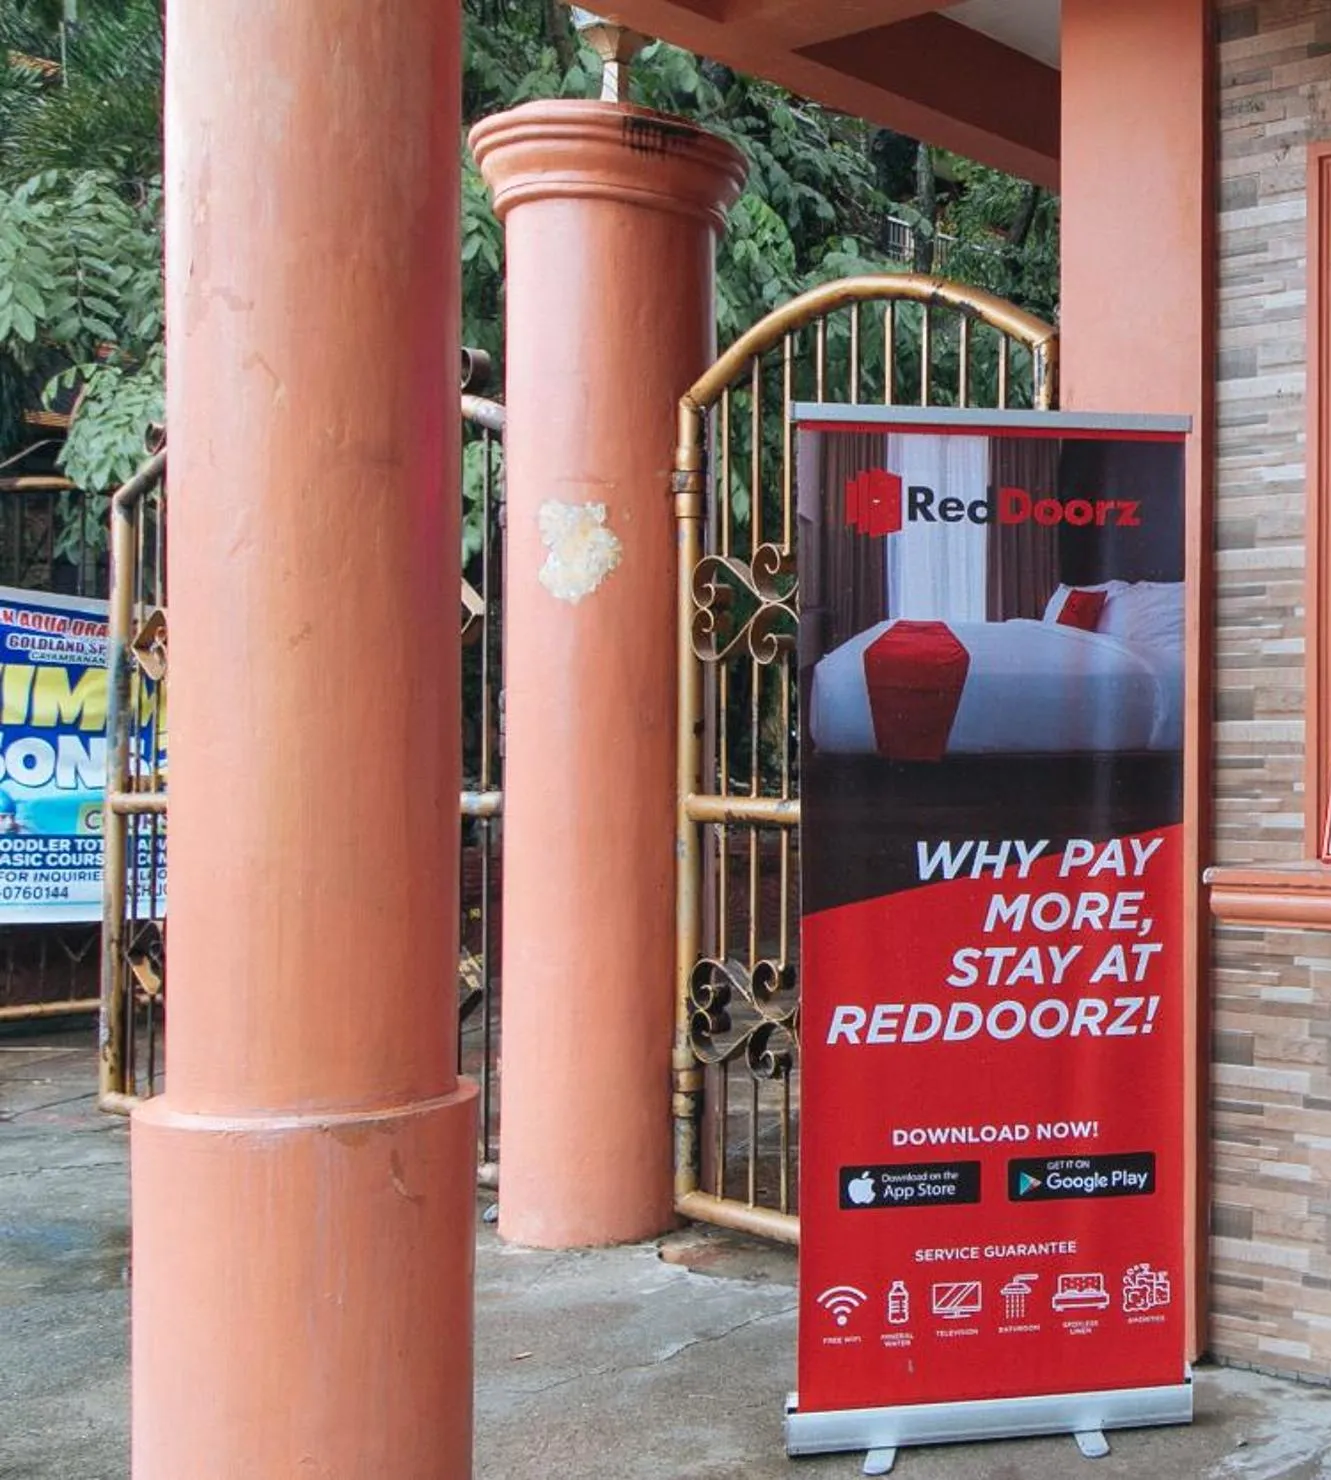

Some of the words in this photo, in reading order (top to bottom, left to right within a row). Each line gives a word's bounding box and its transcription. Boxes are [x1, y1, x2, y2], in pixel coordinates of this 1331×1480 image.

[907, 485, 1142, 527] RedDoorz
[916, 839, 1049, 881] WHY
[1059, 838, 1164, 879] PAY
[982, 891, 1153, 936] MORE,
[946, 944, 1083, 988] STAY
[1089, 943, 1163, 984] AT
[825, 996, 1160, 1045] REDDOORZ!
[892, 1124, 1030, 1147] DOWNLOAD
[1036, 1120, 1100, 1140] NOW!
[881, 1173, 928, 1182] Download
[929, 1173, 942, 1181] on
[943, 1171, 960, 1180] the
[1046, 1160, 1065, 1171] GET
[1066, 1159, 1074, 1170] IT
[1075, 1159, 1090, 1170] ON
[883, 1184, 914, 1200] App
[917, 1182, 957, 1197] Store
[1046, 1172, 1108, 1192] Google
[1111, 1170, 1149, 1189] Play
[914, 1246, 979, 1263] SERVICE
[984, 1240, 1078, 1259] GUARANTEE
